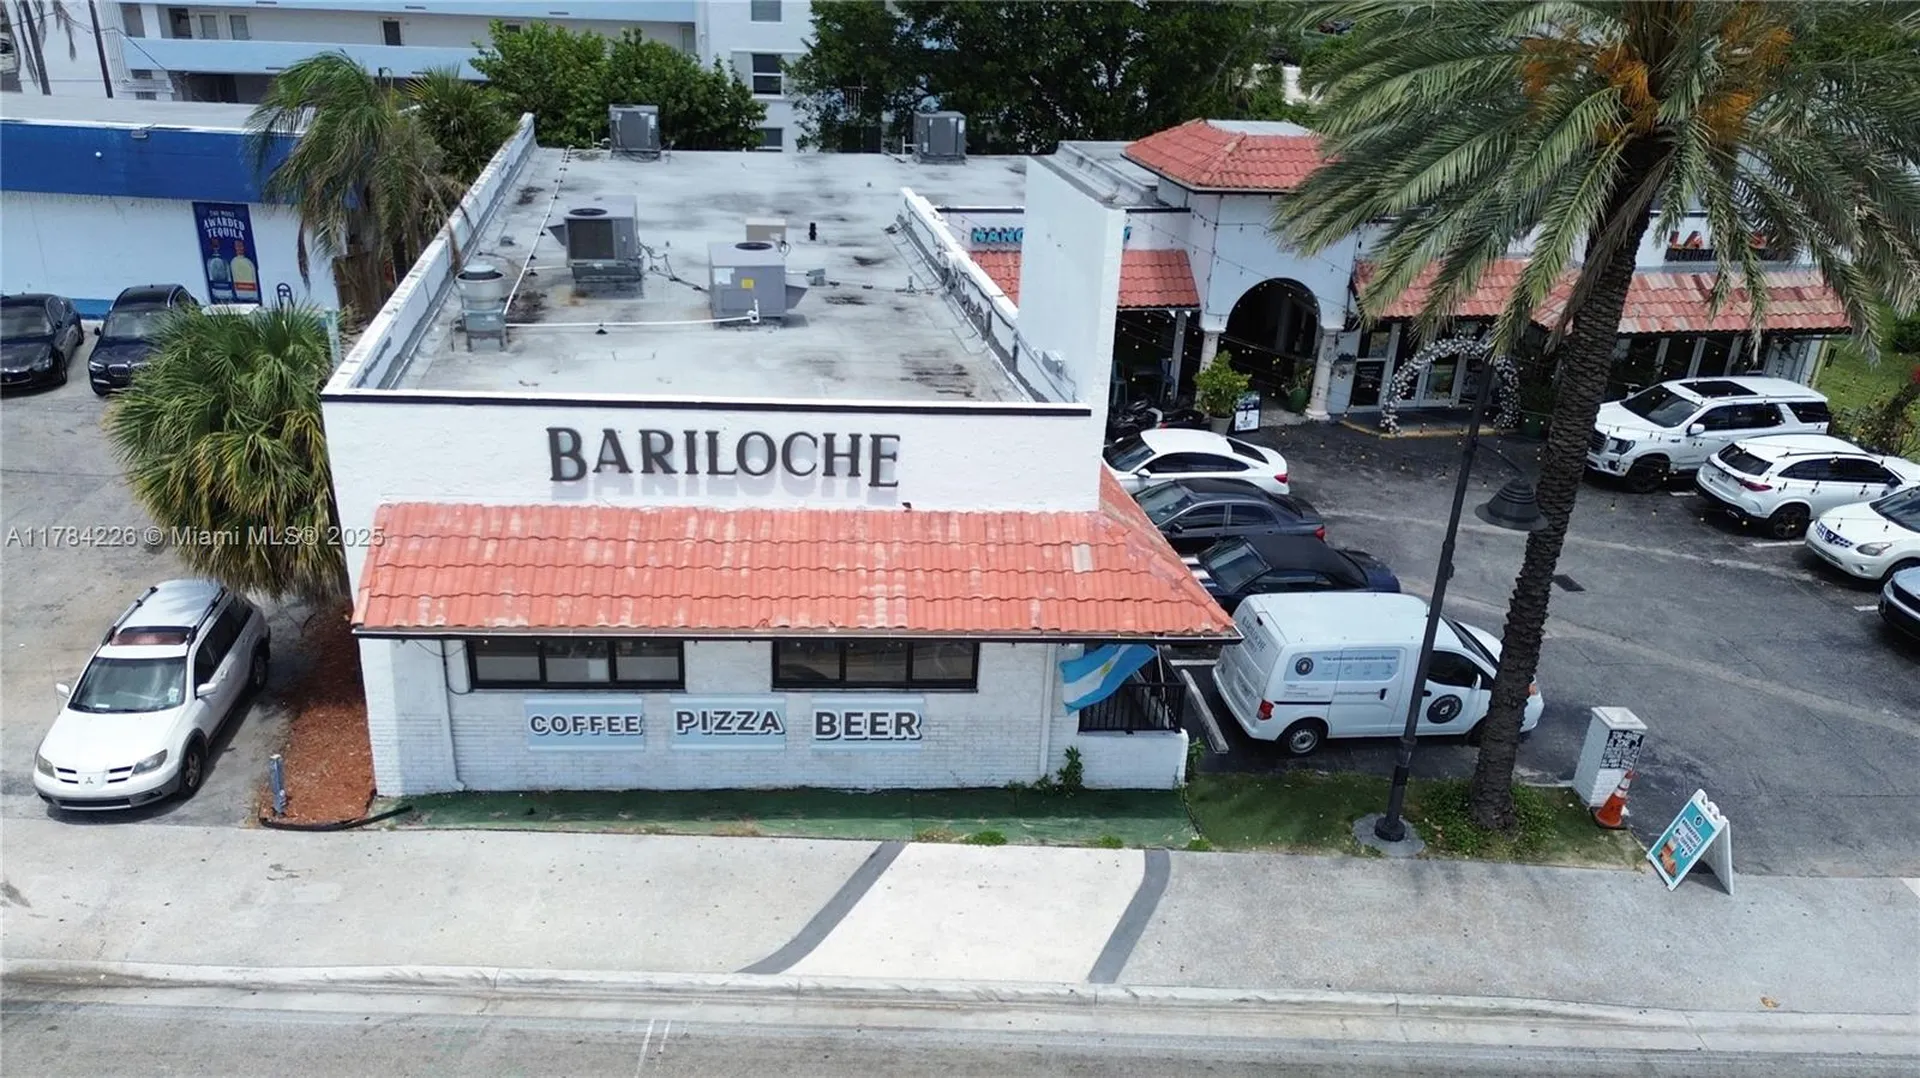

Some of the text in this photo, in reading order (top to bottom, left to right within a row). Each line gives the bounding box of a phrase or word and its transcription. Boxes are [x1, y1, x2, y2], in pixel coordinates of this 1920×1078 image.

[203, 216, 245, 231] AWARDED
[206, 227, 244, 240] TEQUILA
[546, 427, 900, 487] BARILOCHE
[529, 715, 643, 735] COFFEE
[675, 709, 785, 735] PIZZA
[813, 711, 922, 739] BEER
